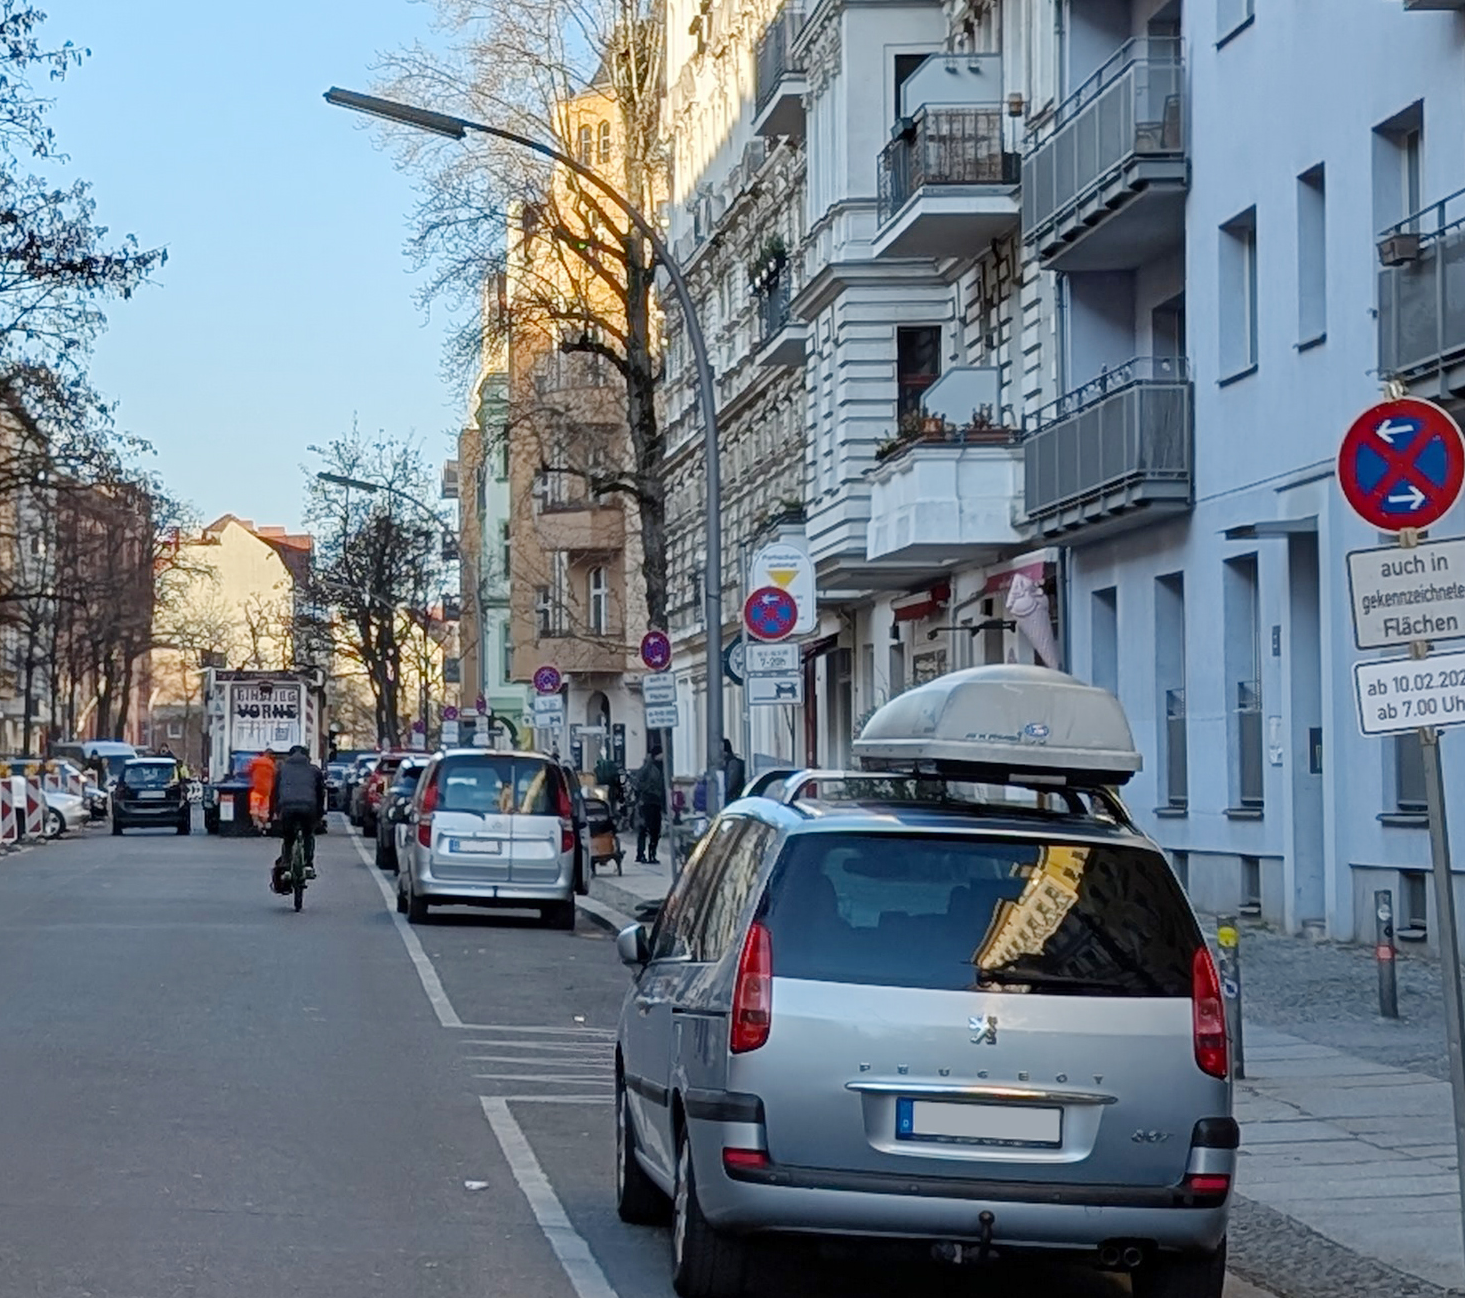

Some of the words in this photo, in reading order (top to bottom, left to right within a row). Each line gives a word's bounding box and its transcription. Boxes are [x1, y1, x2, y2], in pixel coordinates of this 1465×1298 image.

[1381, 555, 1425, 577] auch
[1431, 553, 1449, 571] in
[1384, 615, 1459, 638] Flächen
[1367, 678, 1388, 696] ab
[1377, 704, 1398, 721] ab
[1402, 697, 1438, 718] 7.00
[859, 1062, 1104, 1086] PEUGEOT
